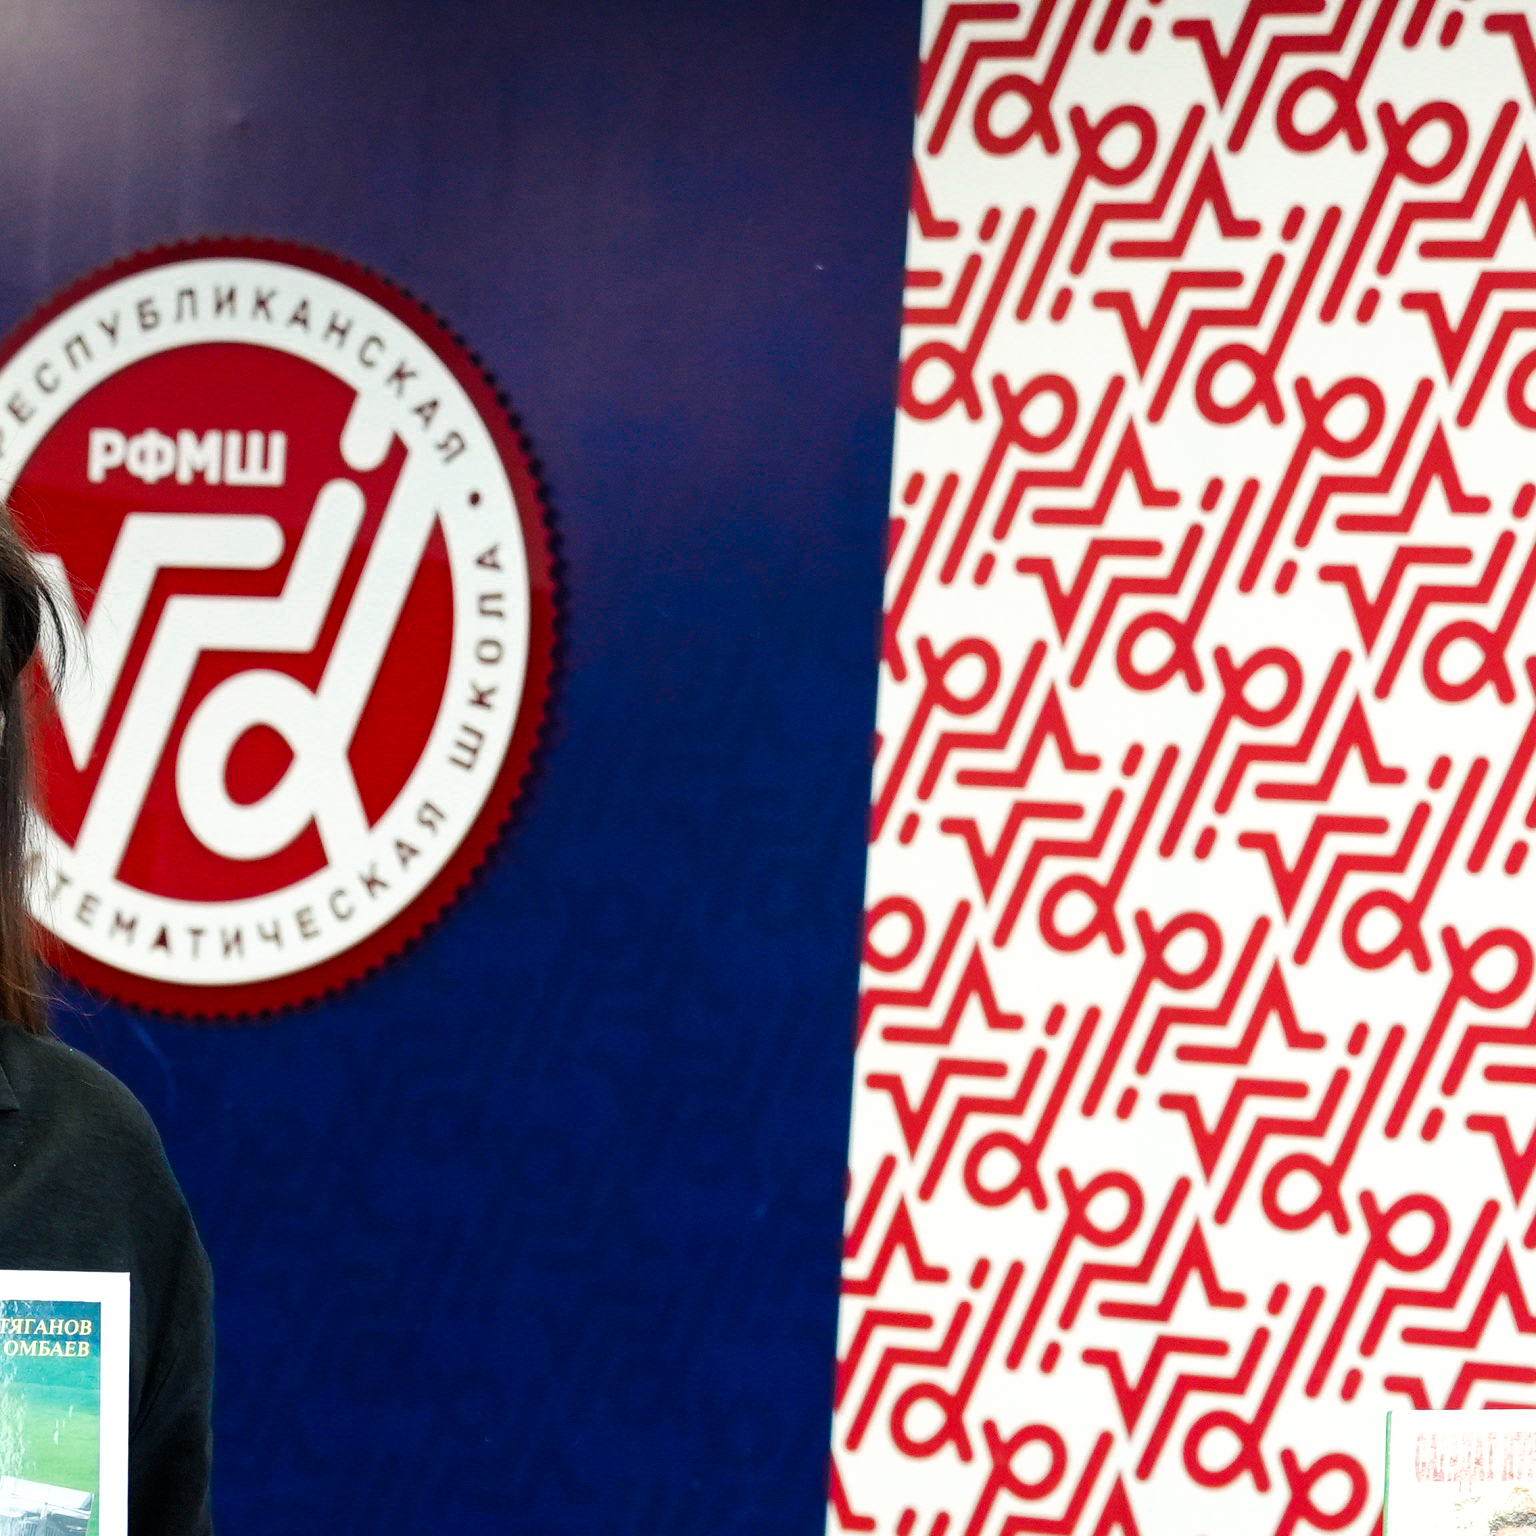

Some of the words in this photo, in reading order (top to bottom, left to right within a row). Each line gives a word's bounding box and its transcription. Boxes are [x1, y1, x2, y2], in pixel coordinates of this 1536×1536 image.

[87, 427, 287, 487] РФМШ
[26, 800, 448, 961] ТЕМАТИЧЕСКАЯ
[450, 542, 505, 773] ШКОЛА
[3, 1340, 90, 1357] ОМБАЕВ
